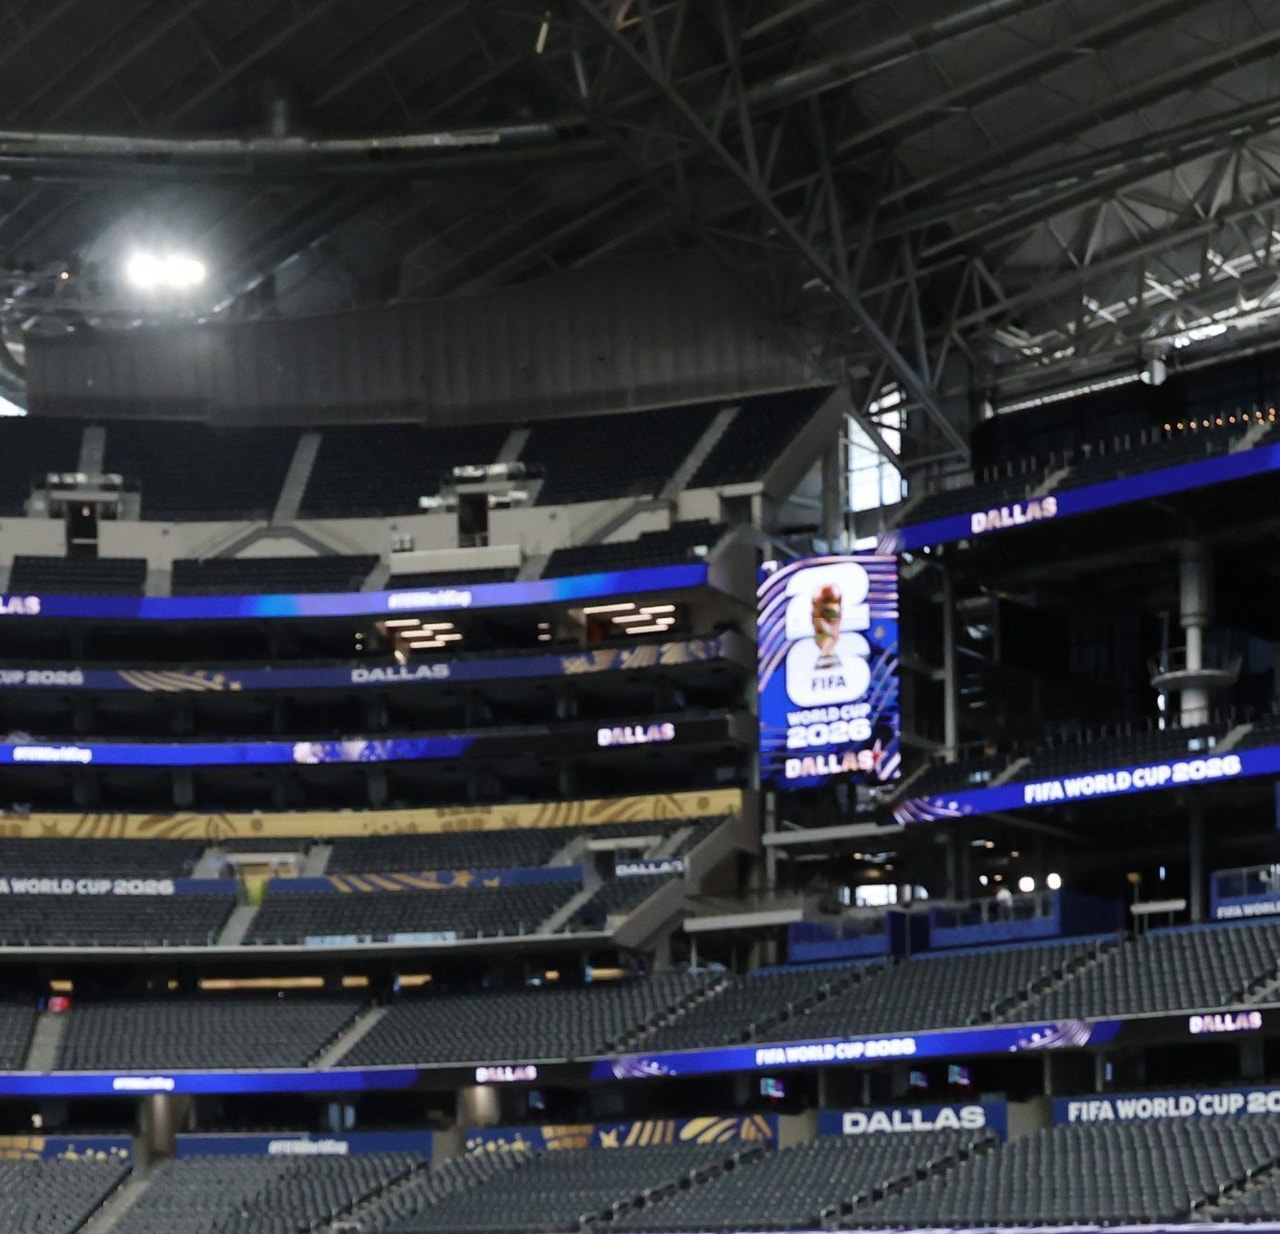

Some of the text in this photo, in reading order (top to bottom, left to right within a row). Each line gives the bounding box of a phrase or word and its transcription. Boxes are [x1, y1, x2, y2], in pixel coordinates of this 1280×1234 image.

[971, 497, 1057, 533] DALLAS
[352, 664, 450, 683] DALLAS
[811, 674, 847, 691] FIFA
[787, 703, 871, 727] WORLD CUP
[598, 723, 675, 746] DALLAS
[786, 718, 871, 748] 2026
[785, 750, 873, 778] DALLAS
[1024, 755, 1240, 803] FIFA WORLD CUP 2026
[10, 878, 76, 894] WORLD
[78, 878, 111, 894] CUP
[1189, 1011, 1261, 1034] DALLAS
[756, 1038, 916, 1066] FIFA WORLD CUP 2026
[843, 1106, 985, 1134] DALLAS
[1068, 1100, 1115, 1122] FIFA
[1118, 1096, 1196, 1119] WORLD
[1199, 1093, 1244, 1115] CUP
